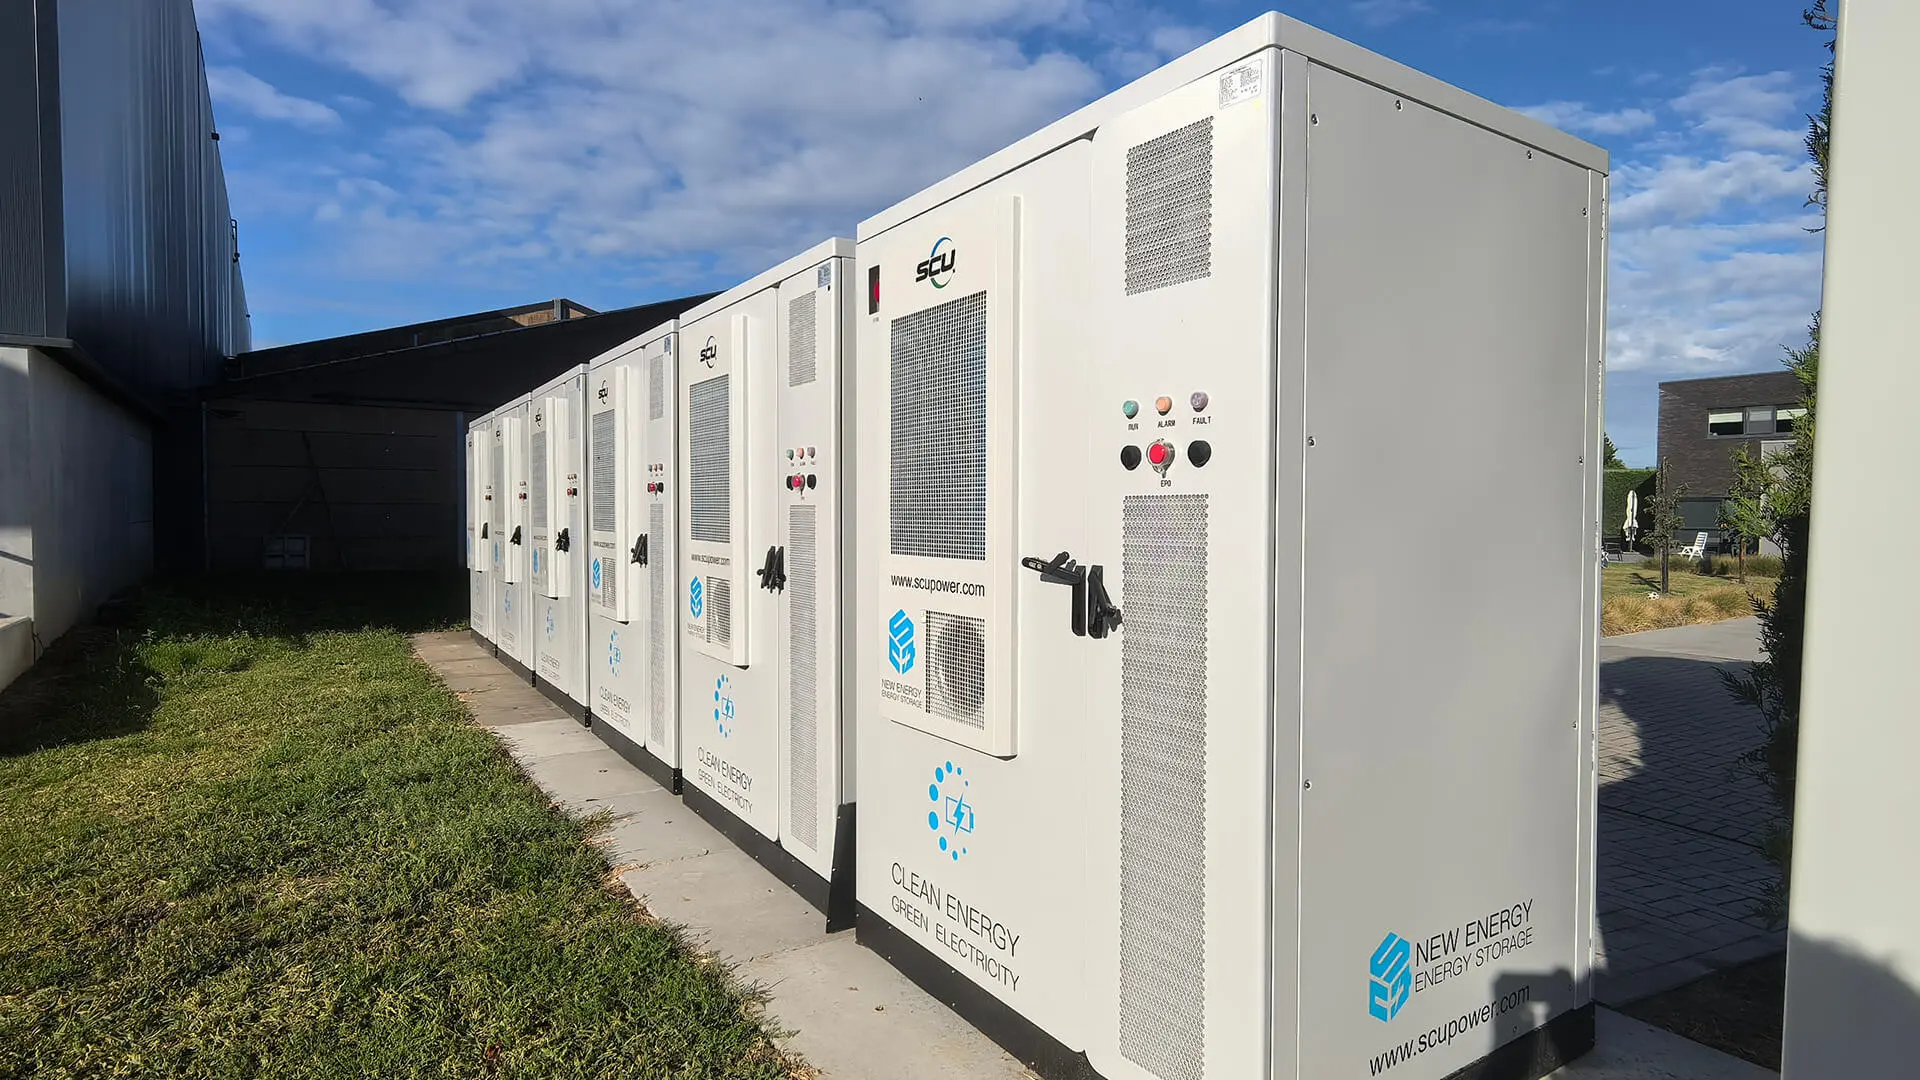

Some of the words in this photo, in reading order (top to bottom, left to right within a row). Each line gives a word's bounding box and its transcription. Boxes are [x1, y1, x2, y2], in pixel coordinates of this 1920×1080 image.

[915, 248, 956, 283] SCU
[699, 344, 717, 362] SCU
[1157, 419, 1176, 428] ALARM
[1192, 416, 1212, 425] FAULT
[1160, 479, 1172, 487] EPO
[890, 574, 986, 597] www.scupower.com
[896, 682, 922, 699] ENERGY
[721, 760, 753, 792] ENERGY
[892, 862, 941, 911] CLEAN
[946, 894, 1020, 957] ENERGY
[891, 895, 929, 933] GREEN
[935, 922, 1020, 992] ELECTRICITY
[1416, 928, 1460, 967] NEW
[1465, 898, 1533, 947] ENERGY
[1415, 953, 1472, 993] ENERGY
[1475, 927, 1534, 968] STORAGE
[1369, 985, 1531, 1077] www.scupower.com
